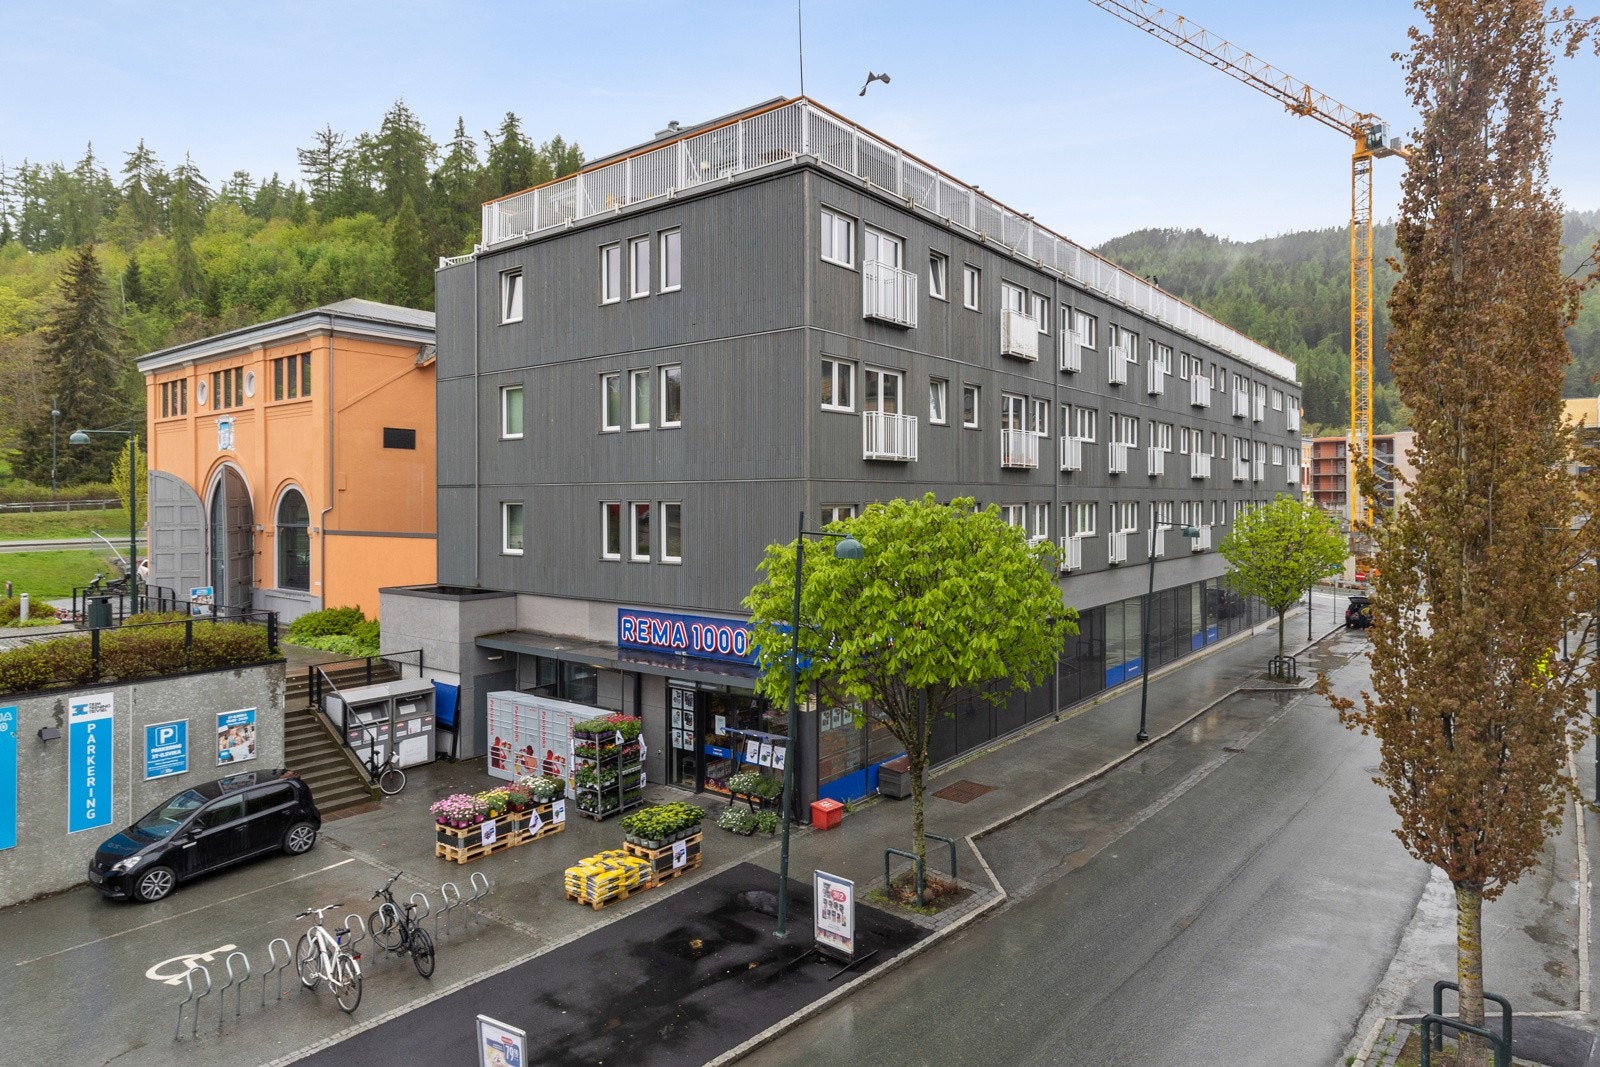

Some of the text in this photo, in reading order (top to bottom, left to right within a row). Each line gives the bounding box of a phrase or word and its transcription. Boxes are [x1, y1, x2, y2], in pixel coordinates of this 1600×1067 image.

[621, 615, 688, 649] REMA
[691, 623, 748, 656] 1000
[151, 743, 182, 753] PARKERING
[160, 728, 174, 744] P
[86, 723, 96, 819] PARKERING
